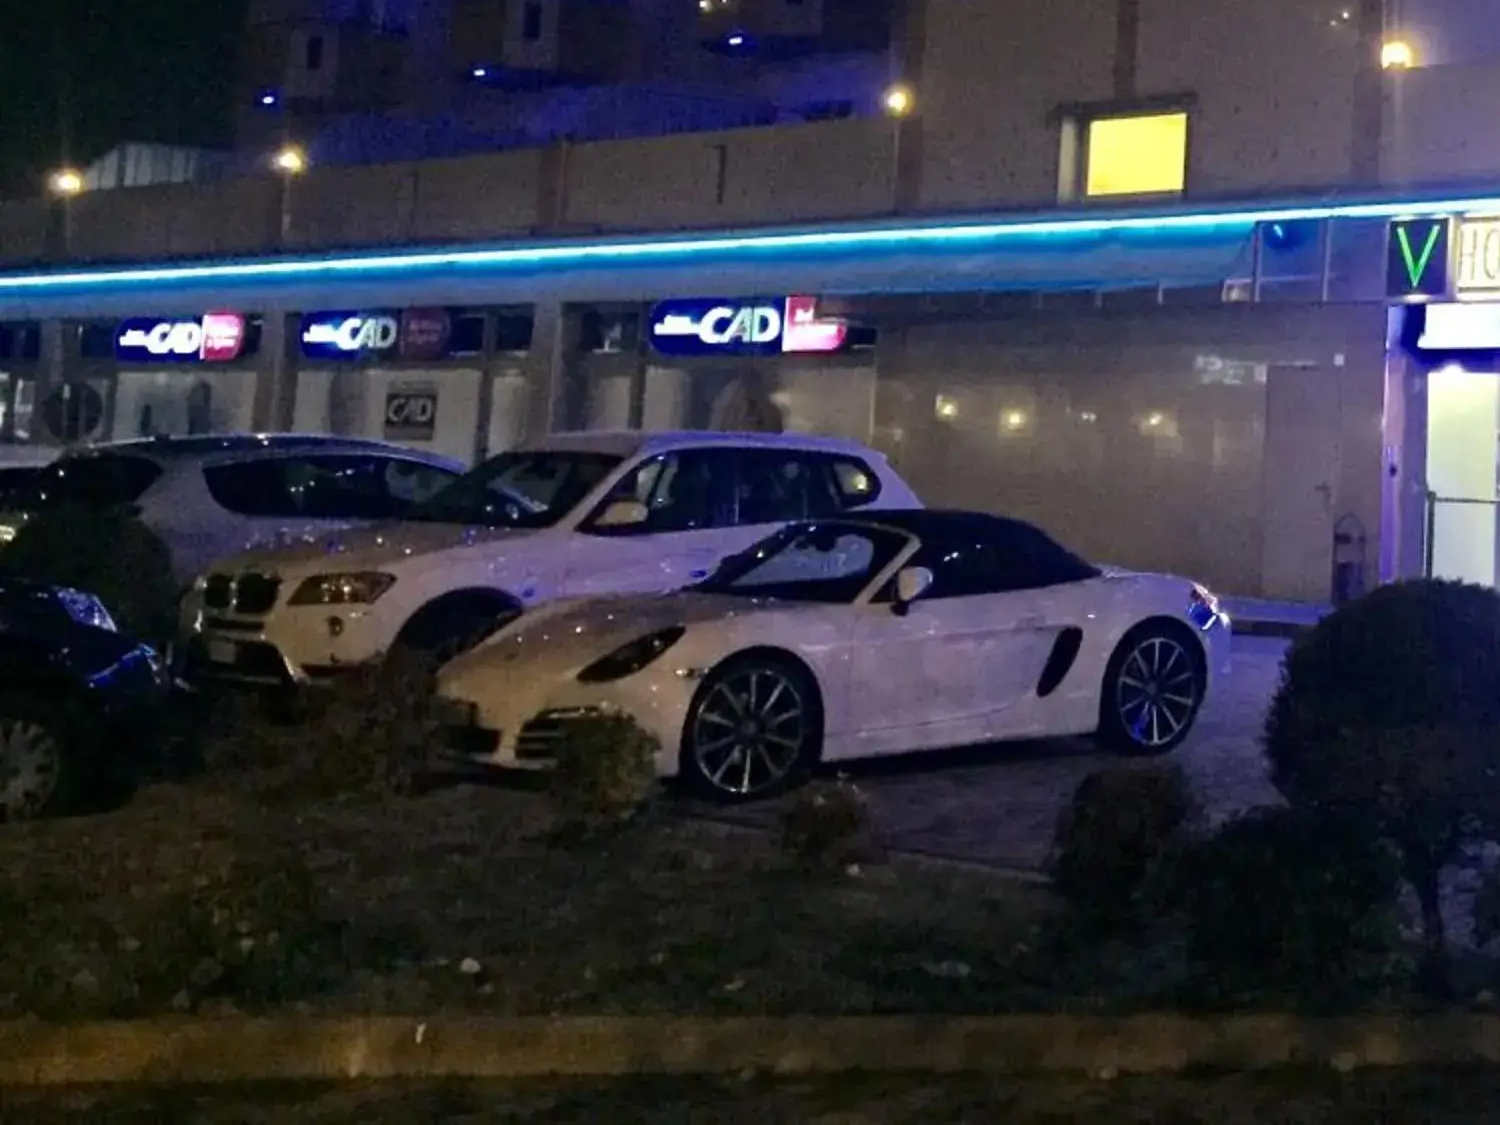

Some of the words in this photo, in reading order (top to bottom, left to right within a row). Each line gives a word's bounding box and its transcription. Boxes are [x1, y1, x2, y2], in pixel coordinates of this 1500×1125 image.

[1397, 224, 1441, 287] V
[336, 317, 398, 350] CAD
[699, 306, 782, 344] CAD
